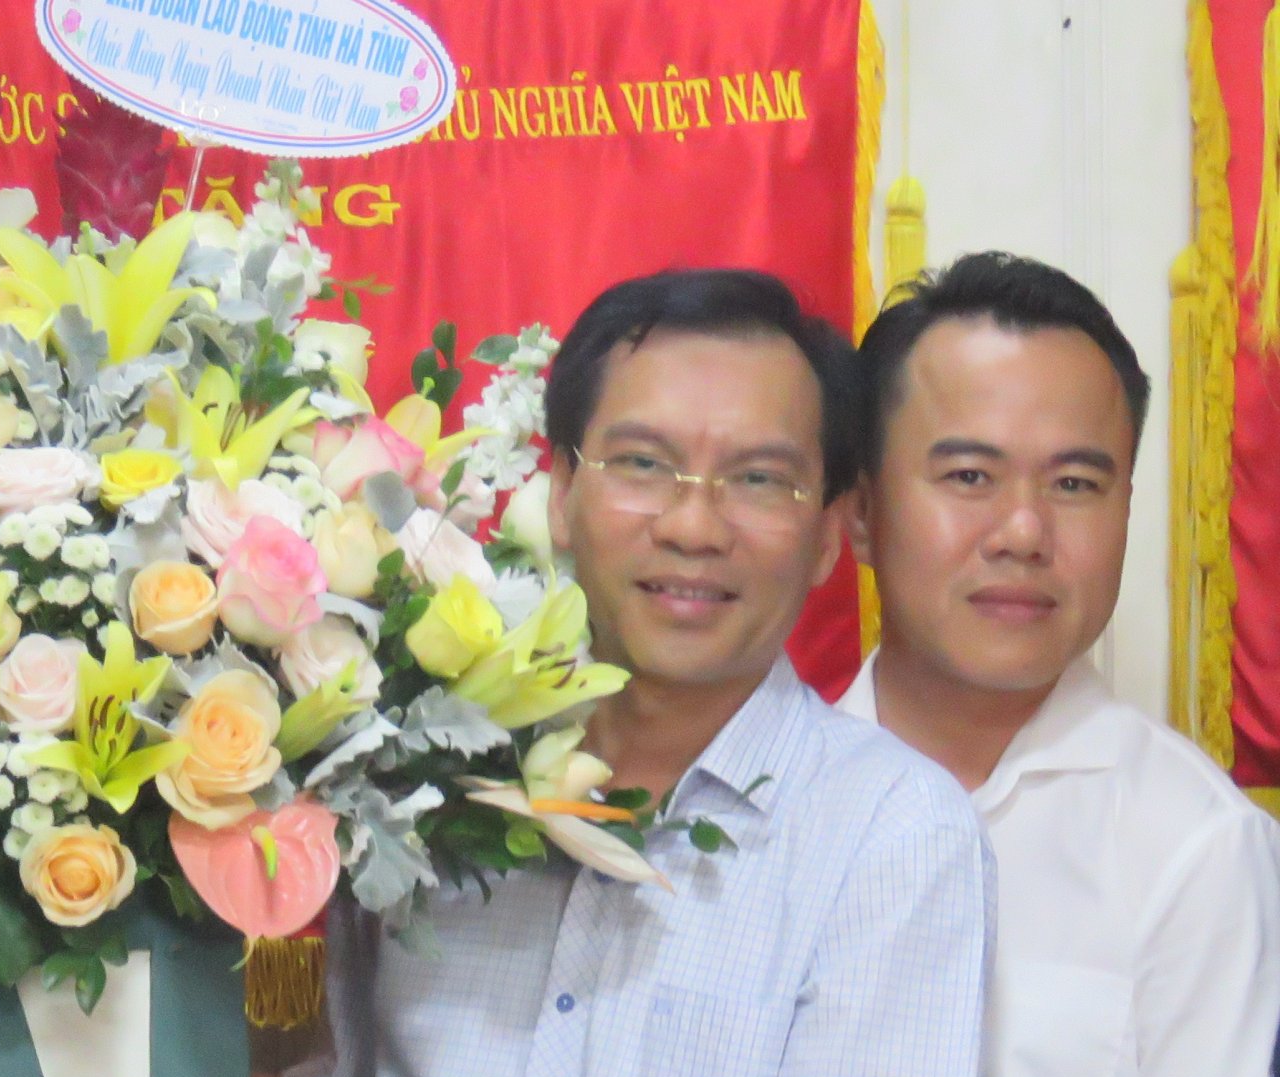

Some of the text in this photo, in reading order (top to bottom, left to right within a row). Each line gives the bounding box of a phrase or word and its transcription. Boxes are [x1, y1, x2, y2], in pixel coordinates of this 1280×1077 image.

[490, 71, 618, 139] NGHĨA
[620, 64, 711, 143] VIỆT
[719, 70, 807, 126] NAM
